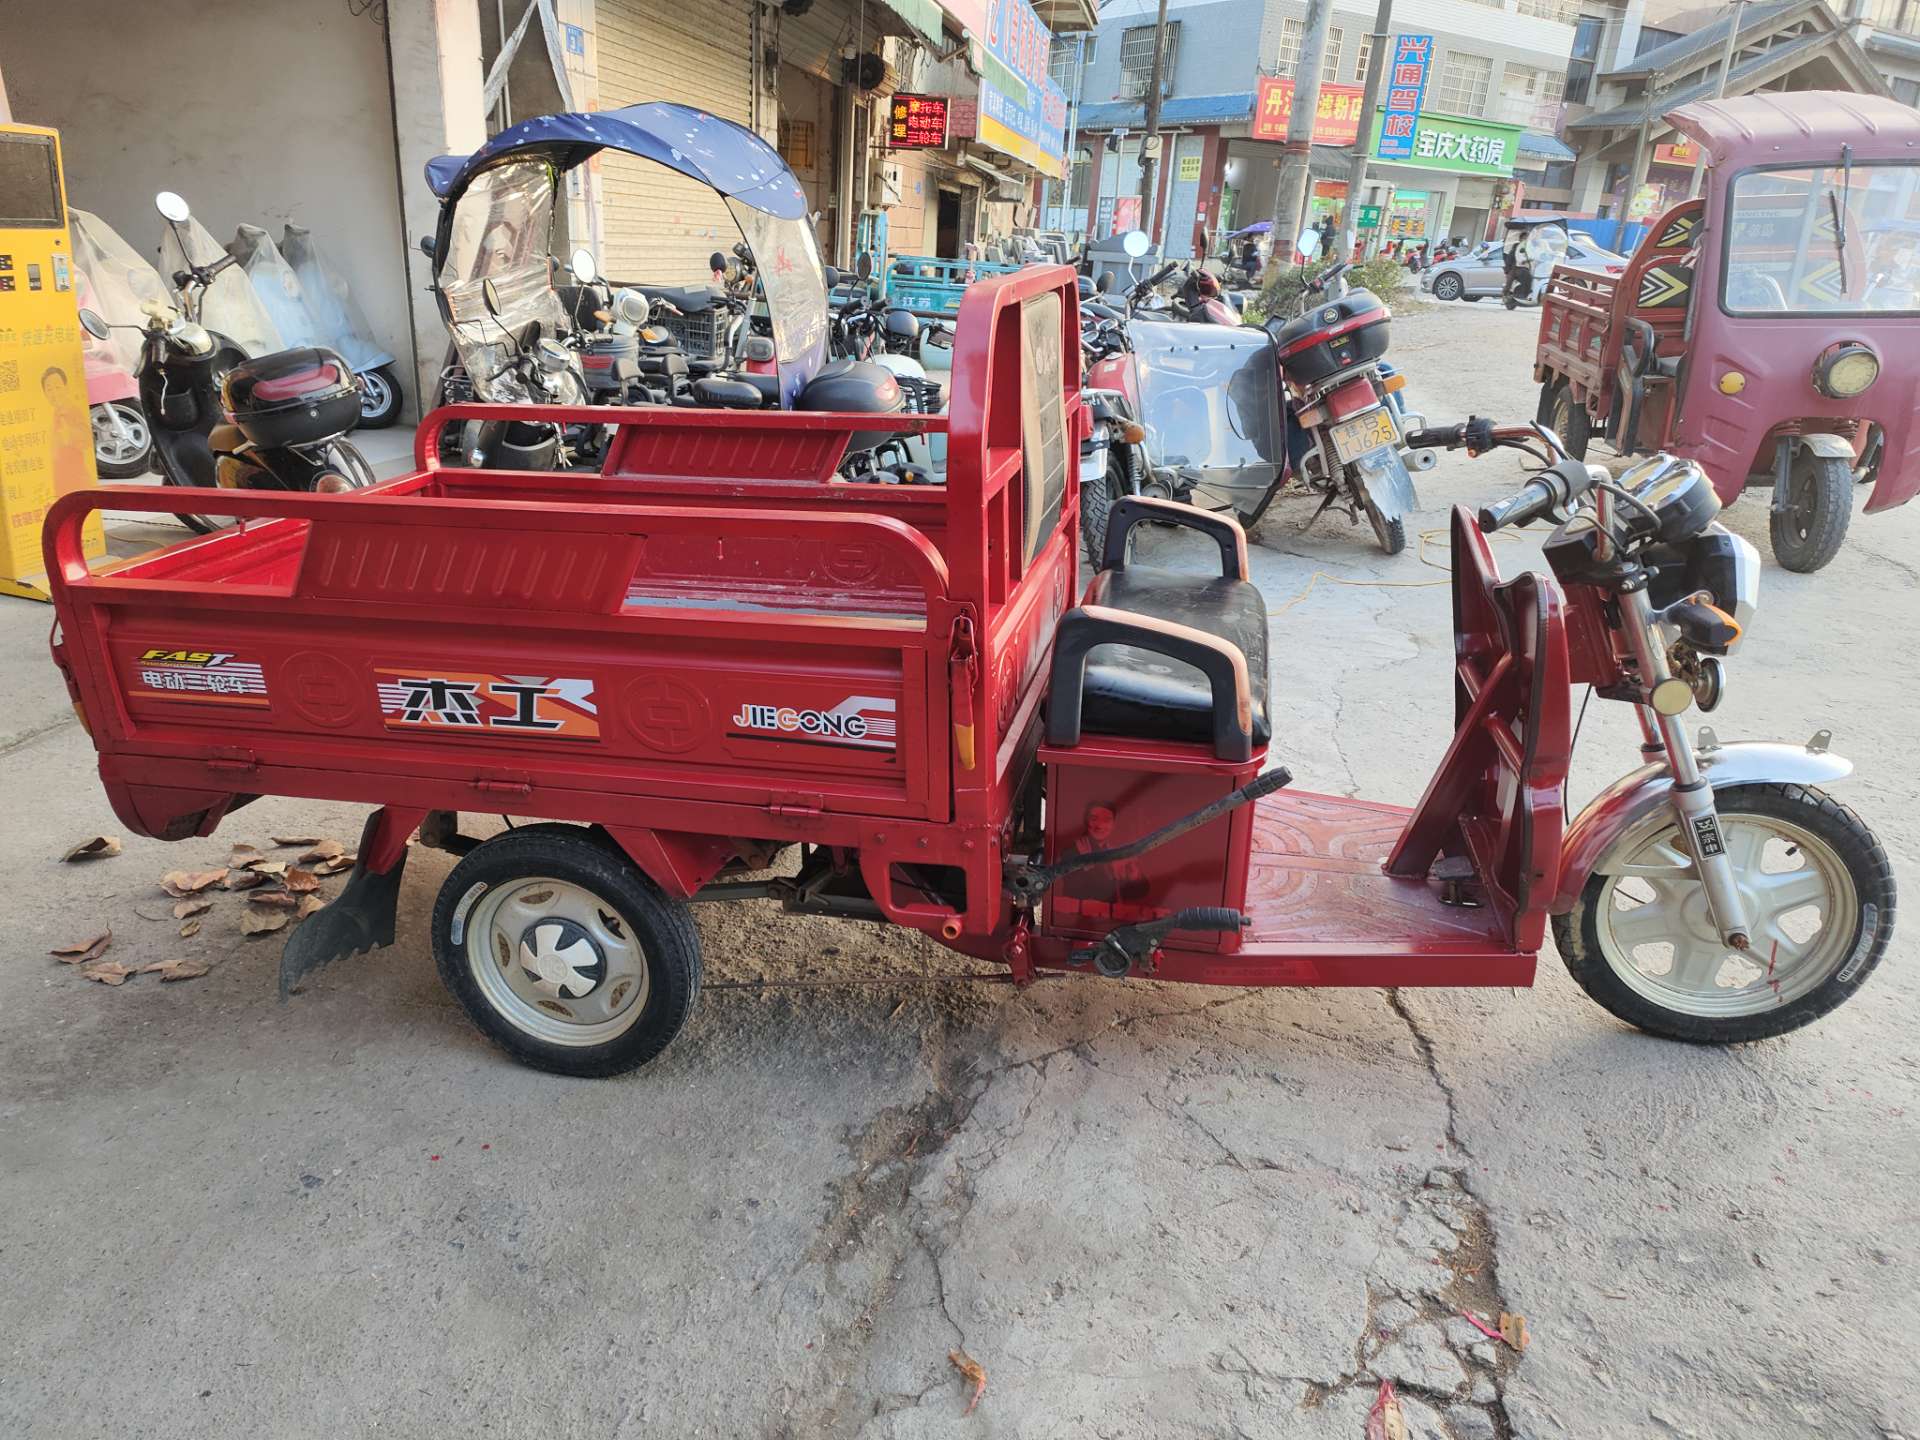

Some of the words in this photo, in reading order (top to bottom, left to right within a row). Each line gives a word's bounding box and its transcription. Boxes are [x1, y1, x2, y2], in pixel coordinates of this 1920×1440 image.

[1385, 38, 1428, 138] 兴通驾校
[893, 105, 907, 138] 修理
[908, 115, 943, 130] 电动车
[909, 101, 944, 115] 摩托车
[907, 131, 942, 145] 三轮车
[1416, 128, 1505, 166] 宝庆大药房
[1340, 424, 1393, 456] TJ625
[141, 649, 235, 668] FAST
[141, 671, 247, 694] 电动三轮车
[398, 678, 566, 732] 杰工
[732, 703, 868, 739] JIEGONG
